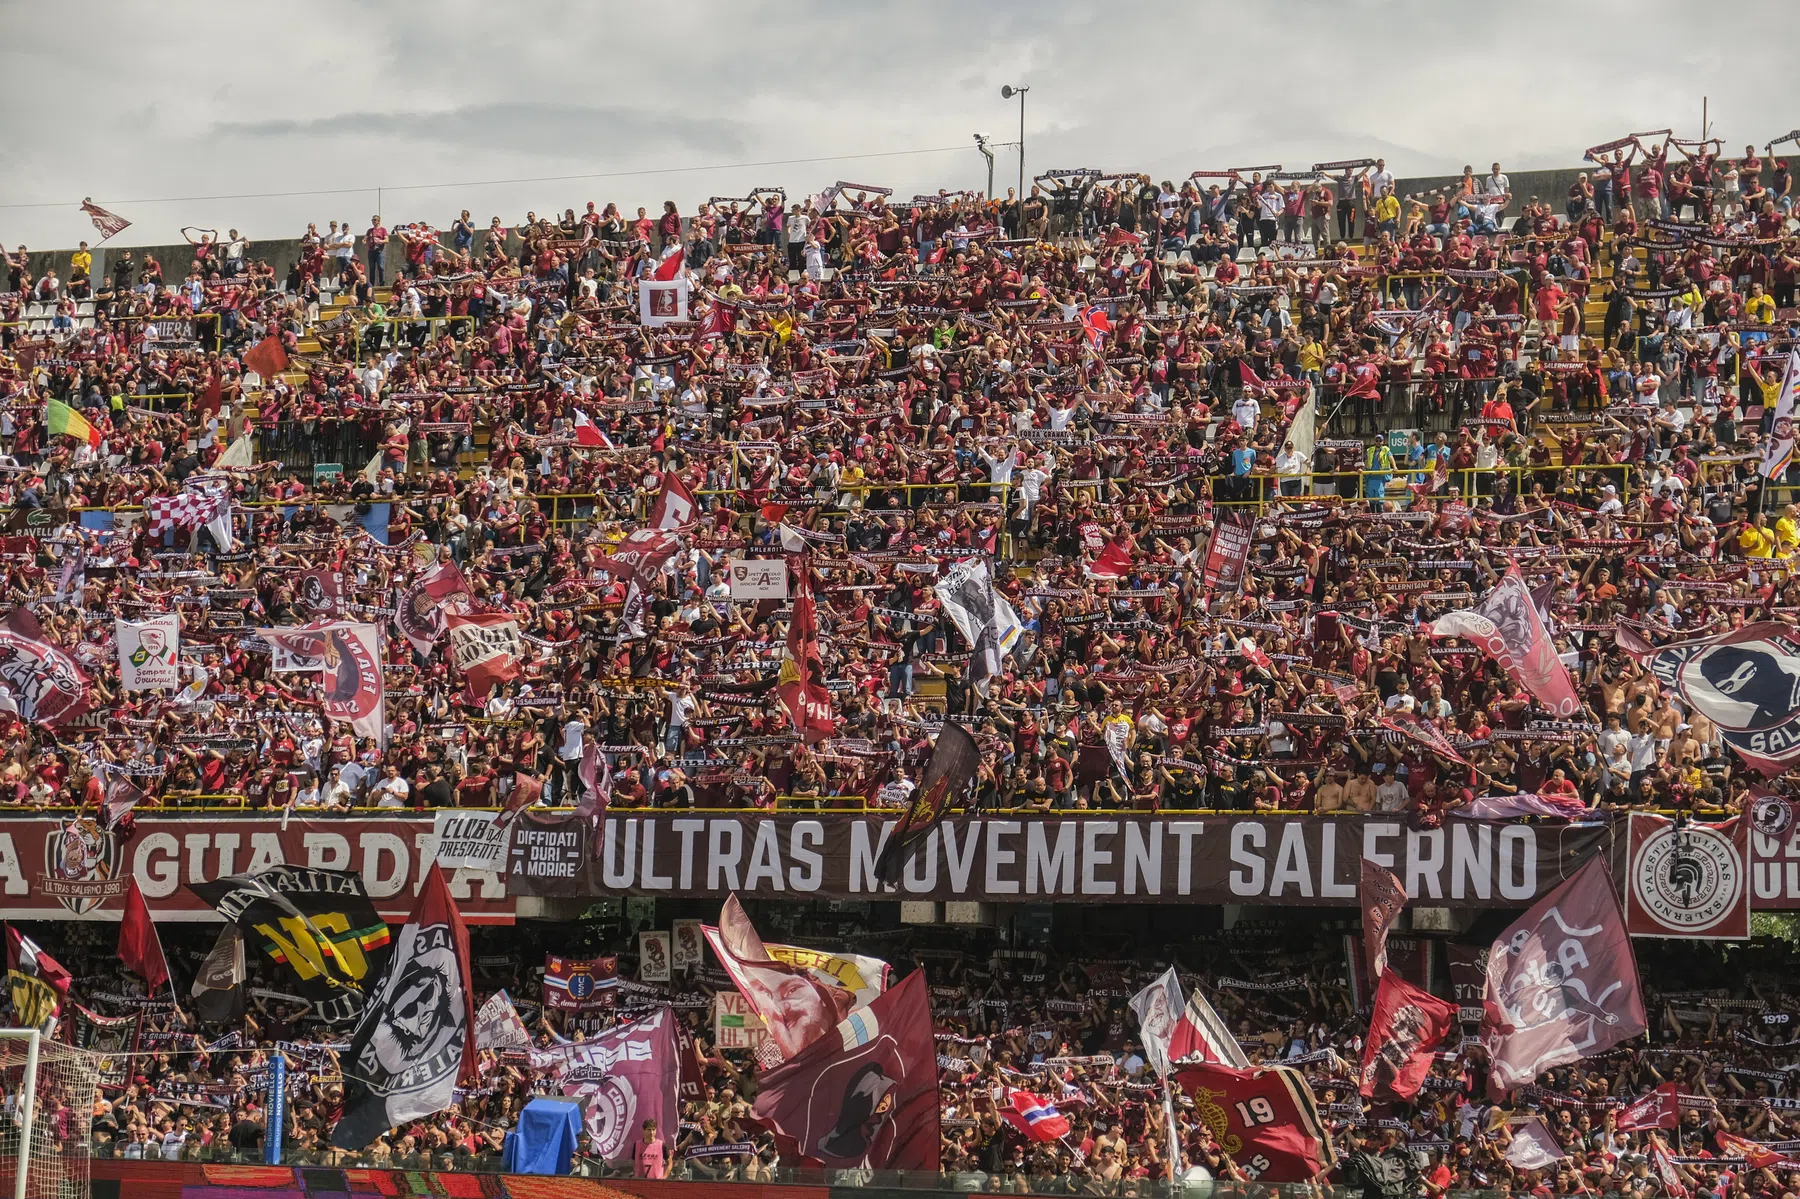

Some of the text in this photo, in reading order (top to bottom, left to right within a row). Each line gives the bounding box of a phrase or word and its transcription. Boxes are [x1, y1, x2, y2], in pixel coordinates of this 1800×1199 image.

[1264, 379, 1306, 388] SALERNO
[1020, 430, 1040, 439] FORZA
[1302, 519, 1323, 527] 1919
[16, 527, 55, 538] RAVELL
[1220, 523, 1243, 535] QUESTA
[1224, 533, 1236, 541] MIA
[1214, 546, 1222, 554] LA
[1216, 539, 1241, 551] DIFENDO
[1387, 581, 1430, 590] SALERNITANA
[1064, 612, 1105, 623] MACTE ANIMO
[136, 668, 167, 677] Sempre
[441, 818, 490, 839] CLUB
[517, 830, 577, 847] DIFFIDATI
[530, 847, 560, 861] DURI
[602, 818, 824, 892] ULTRAS
[849, 819, 1204, 895] MOVEMENT
[1692, 837, 1731, 881] ULTRAS
[513, 860, 575, 877] A MORIRE
[45, 881, 120, 895] ULTRAS SALERNO 1990
[1654, 899, 1722, 922] SALERNO
[1020, 973, 1046, 983] 1919
[1763, 1014, 1790, 1024] 1919
[1235, 1097, 1276, 1128] 19
